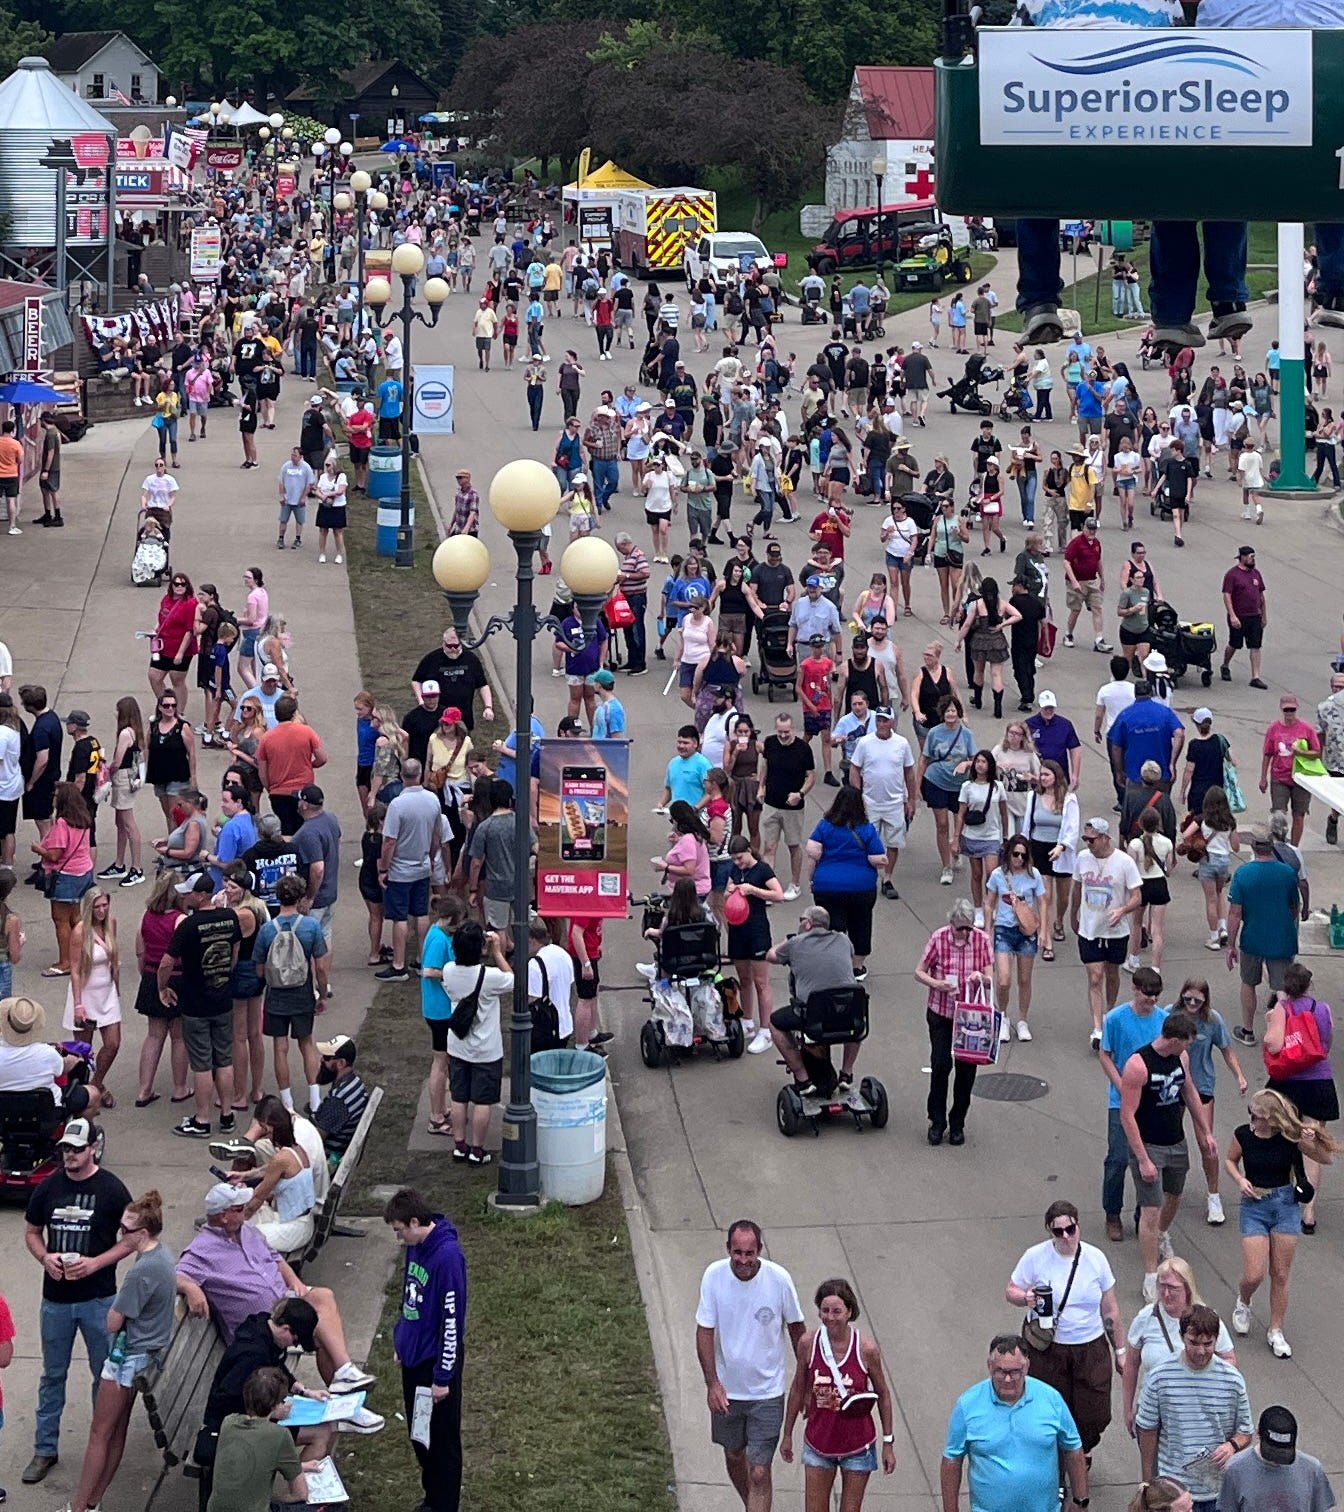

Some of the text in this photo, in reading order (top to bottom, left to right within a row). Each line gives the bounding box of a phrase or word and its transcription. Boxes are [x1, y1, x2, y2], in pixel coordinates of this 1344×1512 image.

[1002, 79, 1290, 123] SuperiorSleep
[1069, 125, 1223, 140] EXPERIENCE
[116, 175, 148, 187] TICK
[27, 308, 39, 361] BEER
[4, 373, 36, 383] HERE
[544, 874, 575, 883] GET THE
[578, 885, 594, 894] APP
[441, 1290, 457, 1372] UP NORTH
